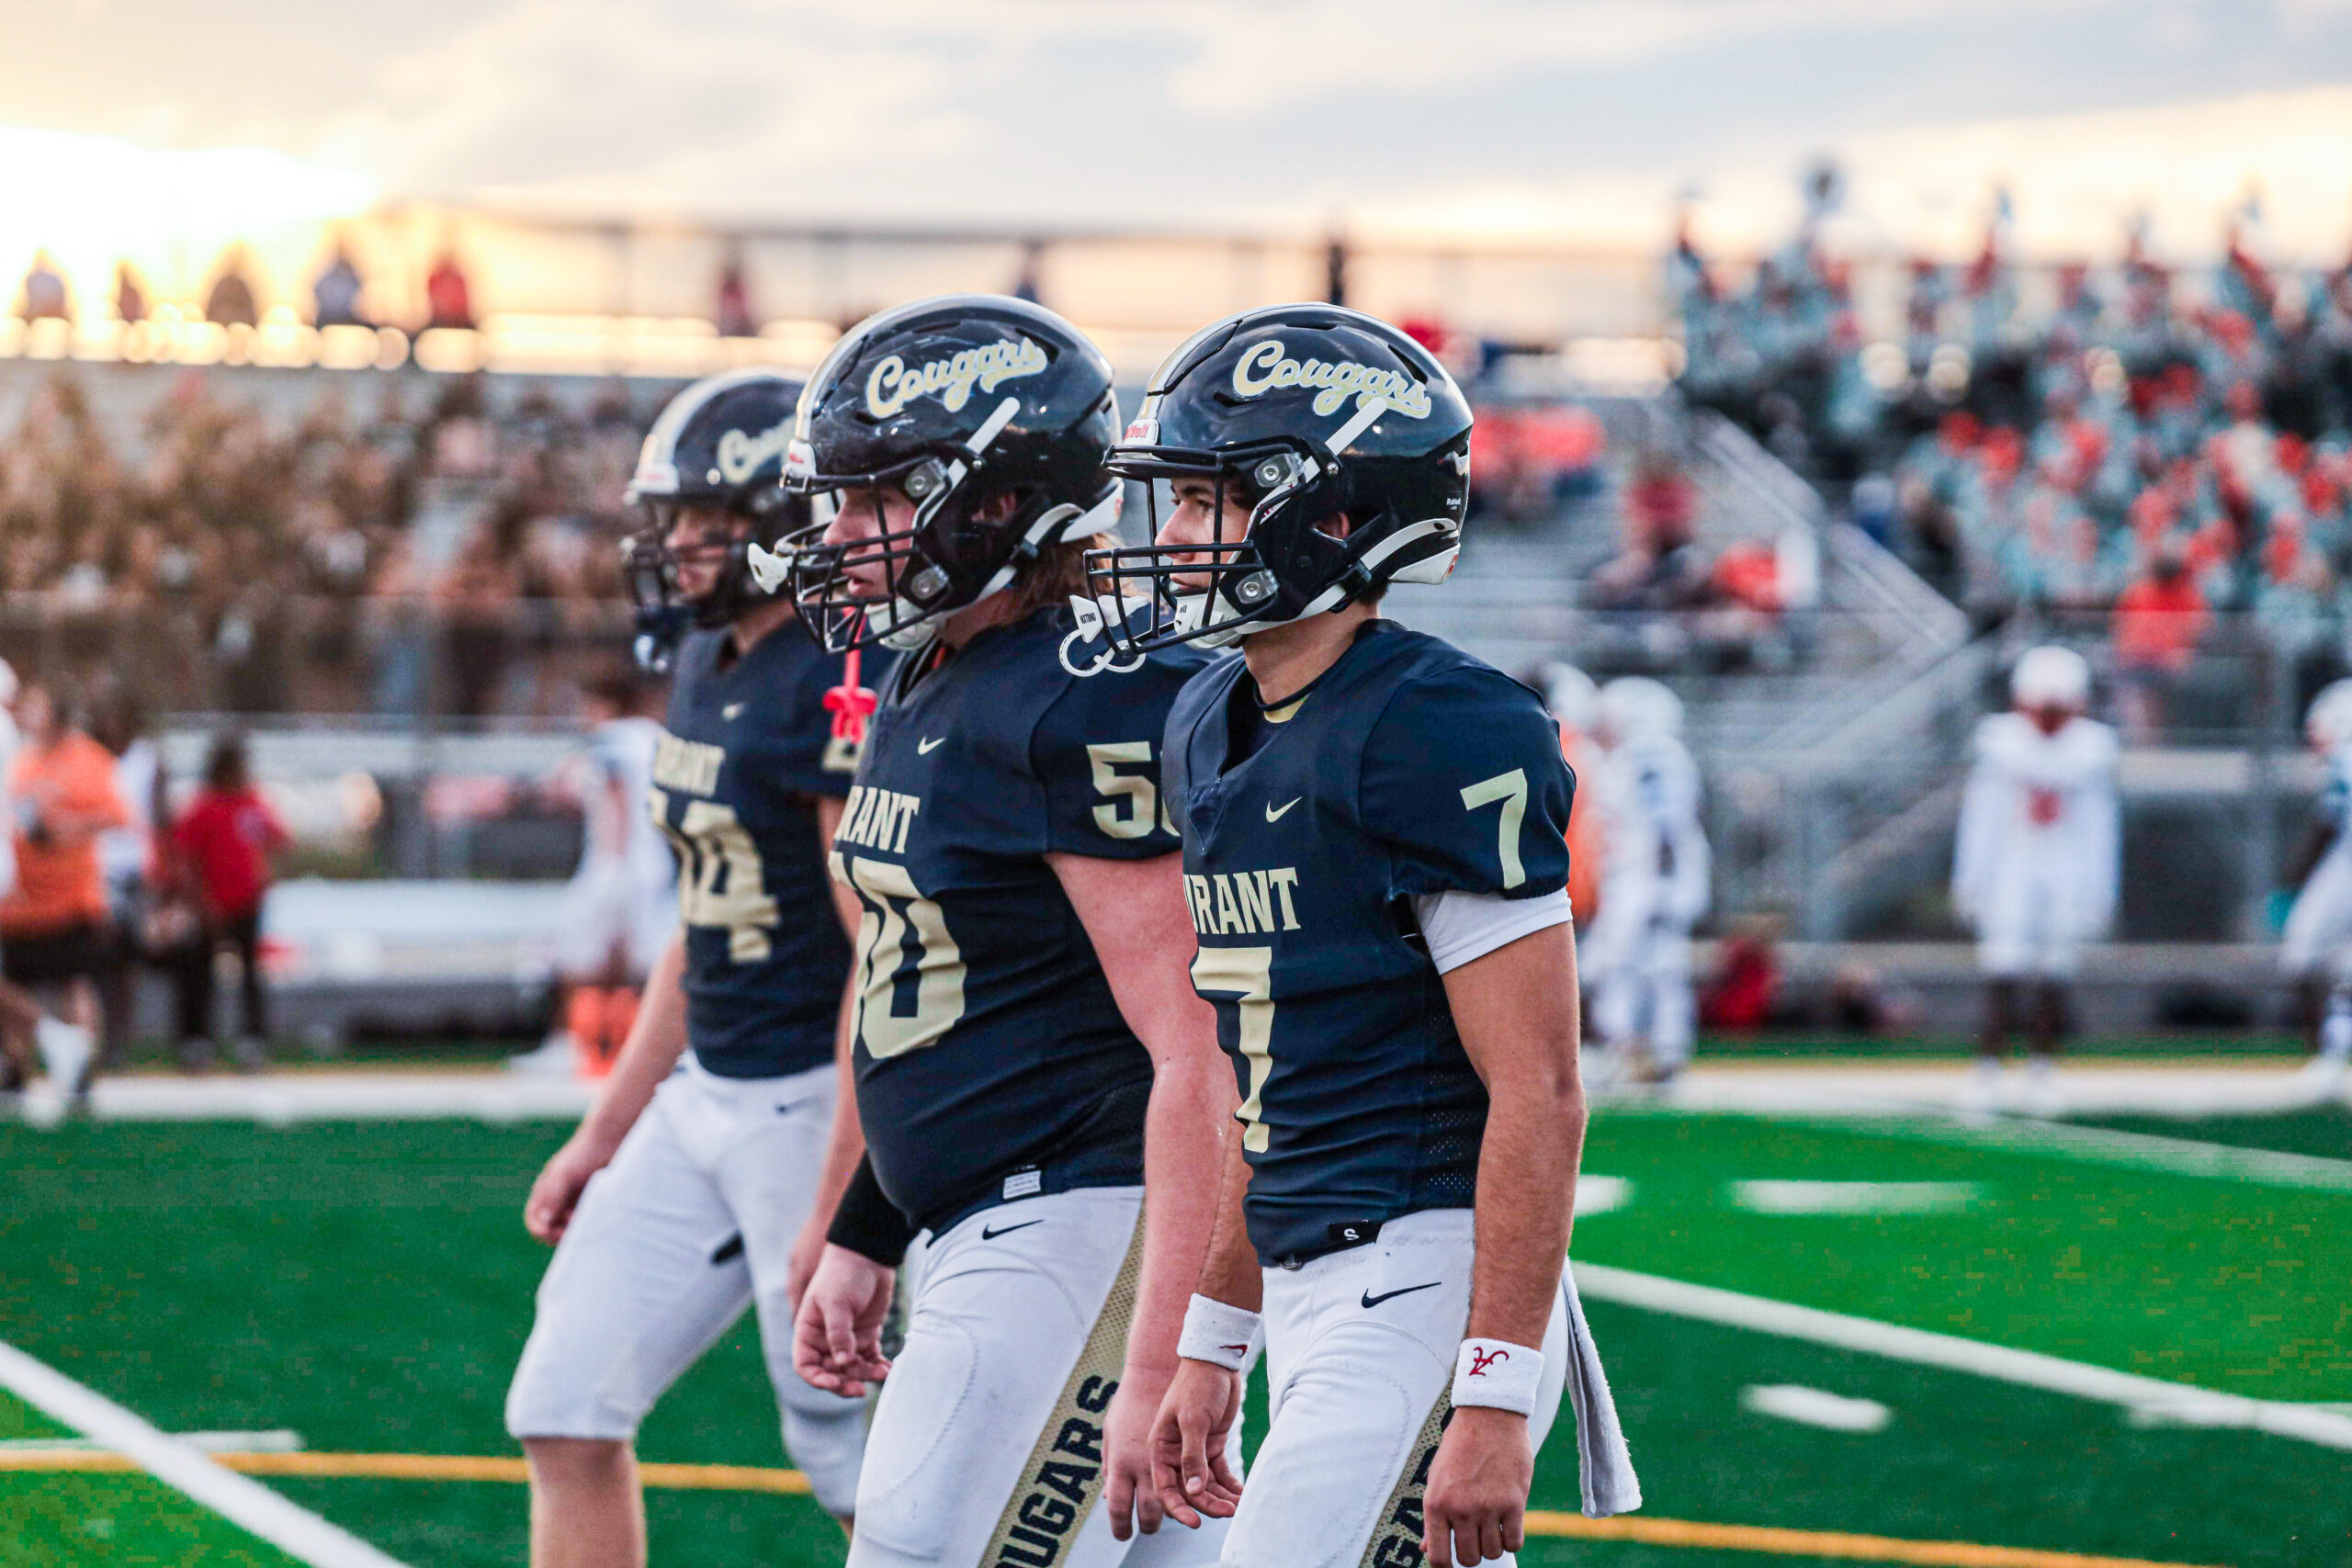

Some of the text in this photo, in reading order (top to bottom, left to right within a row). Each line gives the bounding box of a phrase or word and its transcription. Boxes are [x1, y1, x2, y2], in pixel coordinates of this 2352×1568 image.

[866, 336, 1047, 419] Cougars
[1232, 340, 1431, 419] Cougars
[833, 784, 920, 854] RANT
[1086, 740, 1182, 840] 5
[1460, 767, 1528, 890] 7
[1190, 945, 1275, 1154] 7
[994, 1374, 1120, 1568] UGARS
